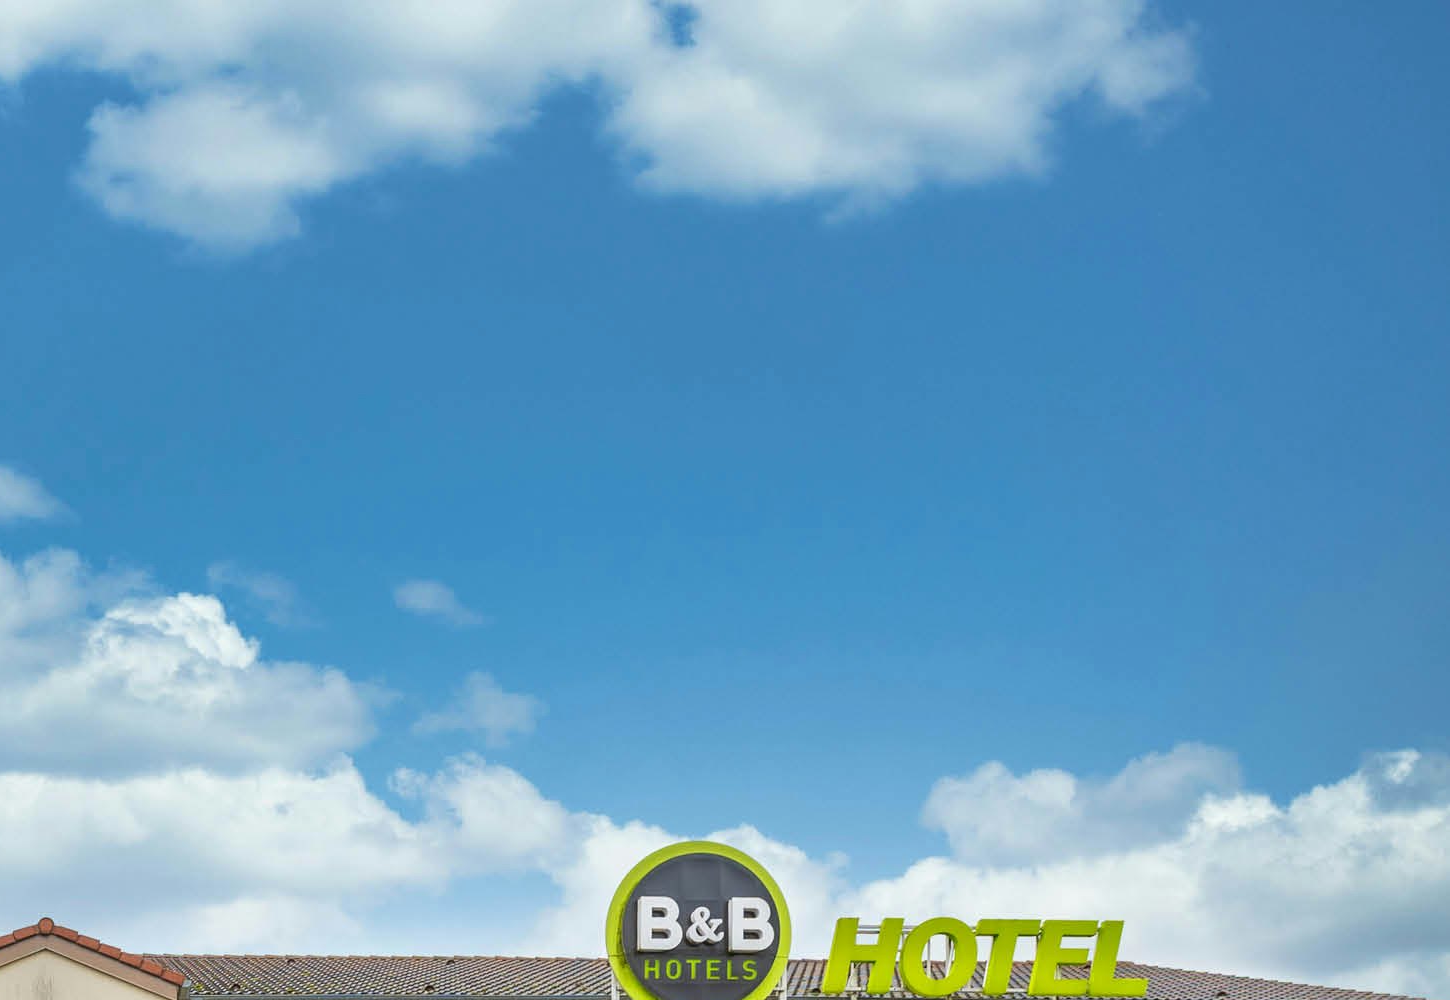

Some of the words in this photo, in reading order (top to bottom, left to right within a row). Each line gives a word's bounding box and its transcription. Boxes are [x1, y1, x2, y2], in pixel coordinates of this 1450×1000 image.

[637, 895, 775, 954] B&B
[644, 958, 759, 982] HOTELS
[821, 916, 1148, 998] HOTEL
